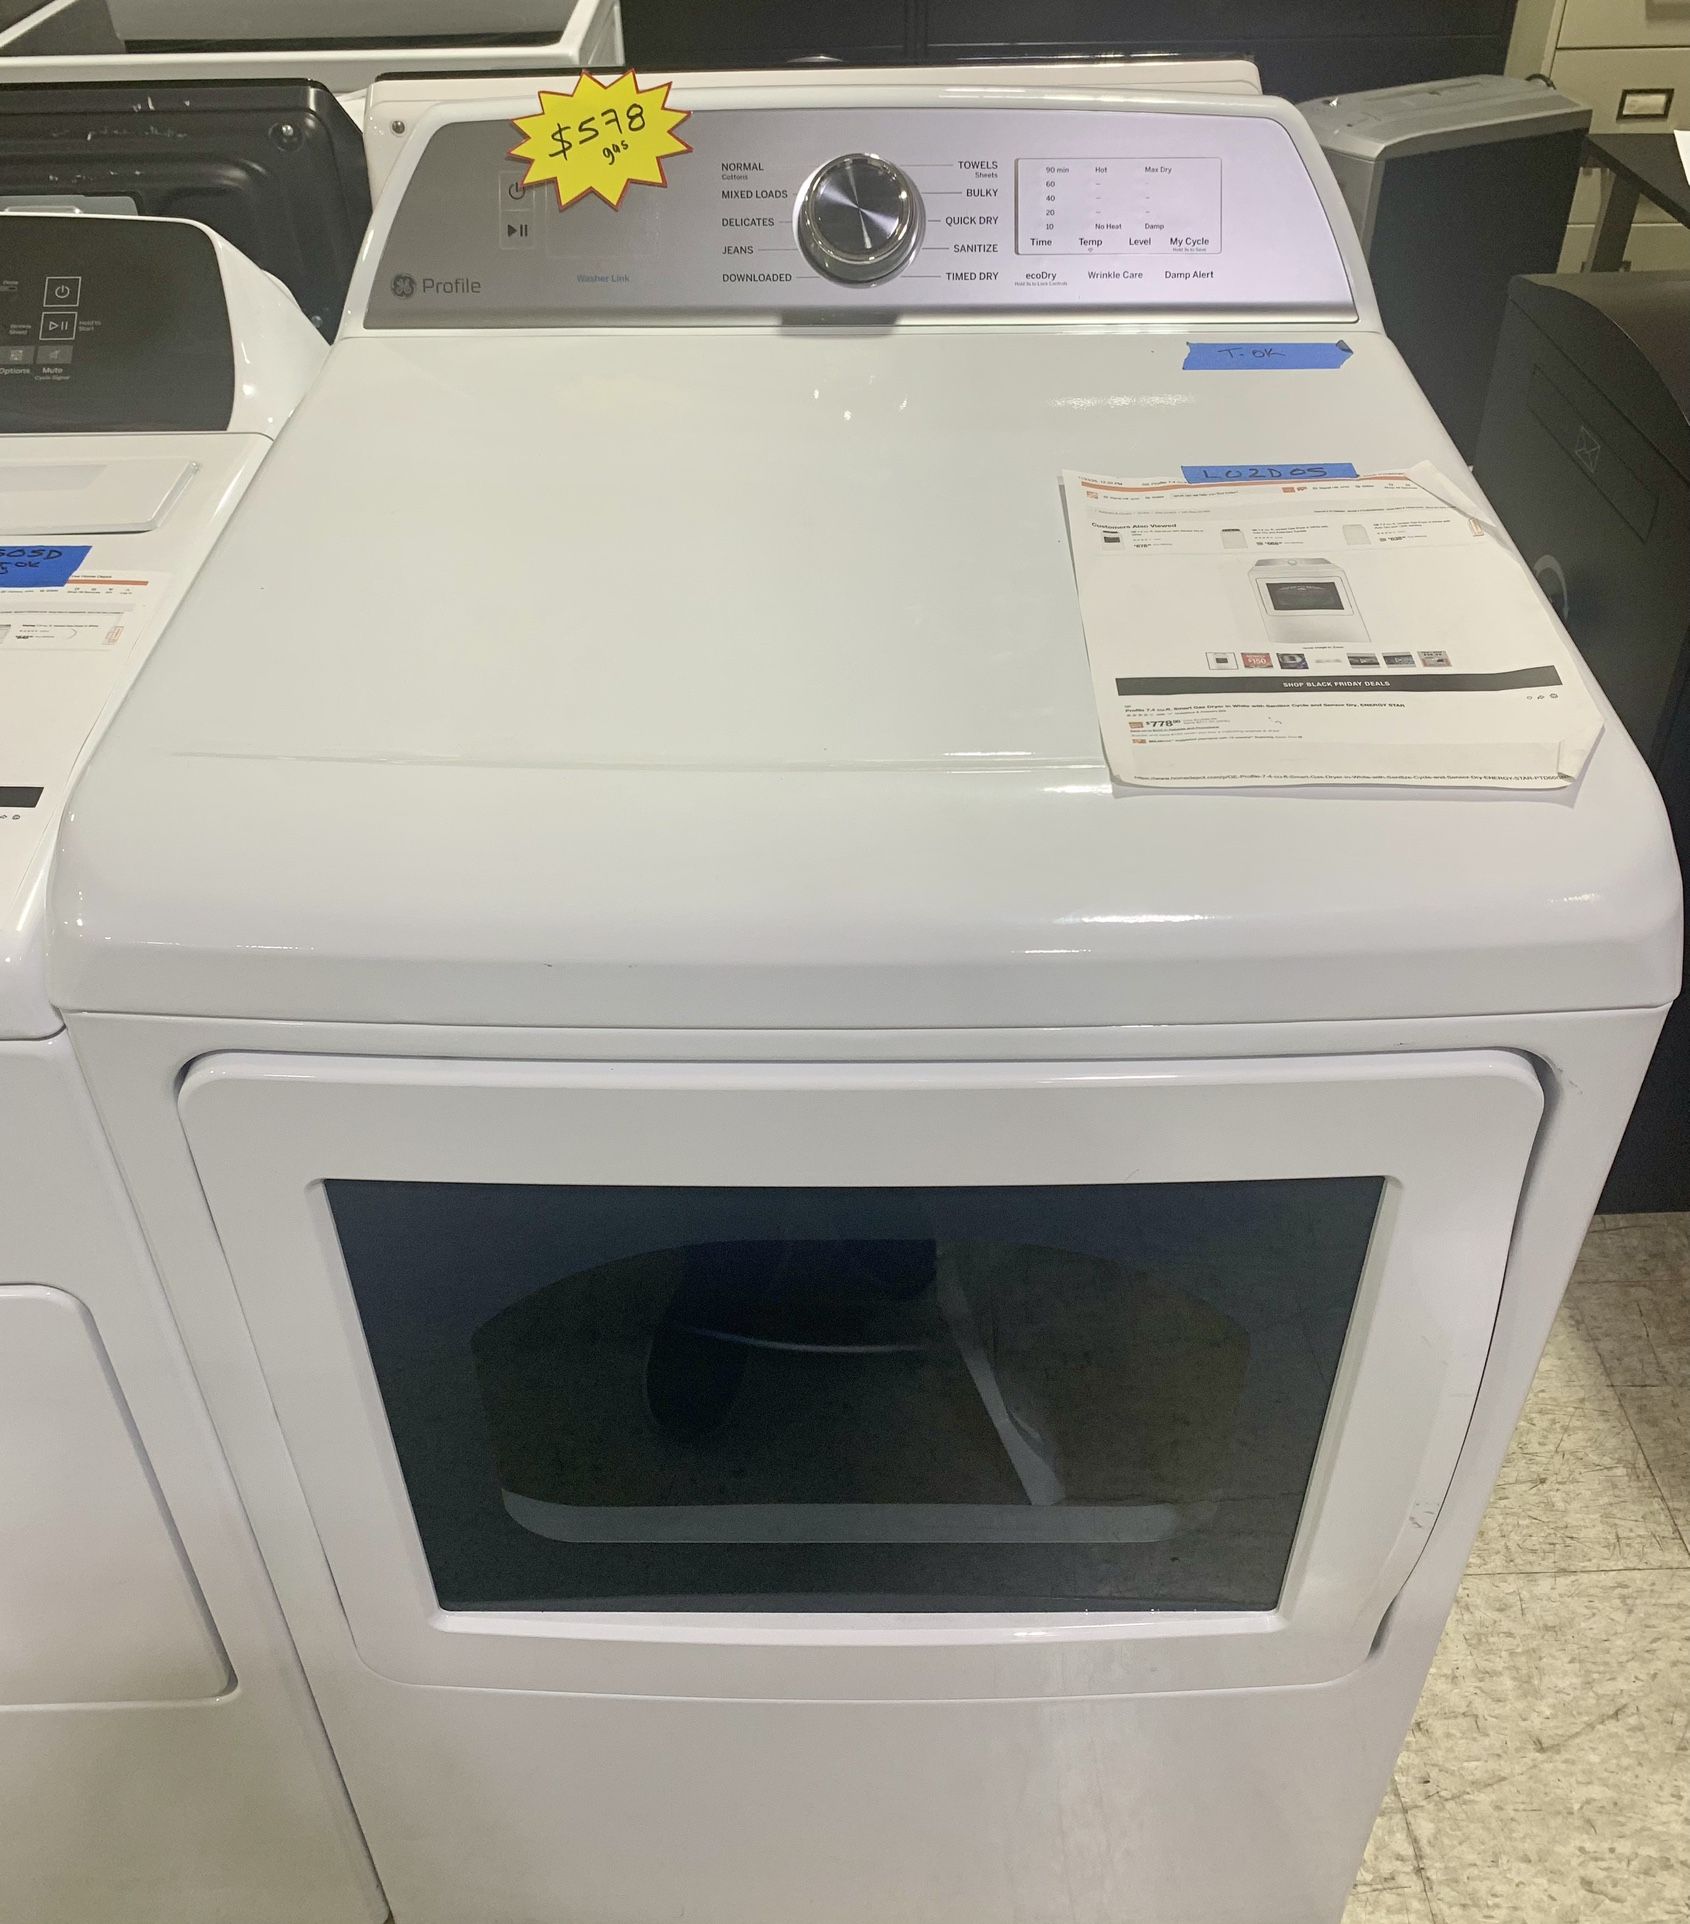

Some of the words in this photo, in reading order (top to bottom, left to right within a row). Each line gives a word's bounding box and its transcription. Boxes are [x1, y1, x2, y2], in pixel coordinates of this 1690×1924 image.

[549, 103, 646, 161] $578
[602, 140, 629, 165] gas
[721, 162, 764, 172] NORMAL
[958, 161, 998, 170] TOWELS
[1045, 166, 1056, 174] 90
[1057, 166, 1070, 174] min
[1095, 166, 1108, 174] Hot
[1144, 166, 1159, 174] Max
[1160, 166, 1173, 175] Dry
[1045, 180, 1056, 188] 60
[721, 190, 753, 199] MIXED
[755, 190, 788, 199] LOADS
[966, 188, 999, 198] BULKY
[1045, 194, 1056, 202] 40
[721, 218, 775, 227] DELICATES
[945, 216, 977, 227] QUICK
[979, 216, 999, 225] DRY
[1144, 223, 1165, 231] Damp
[1030, 237, 1053, 247] Time
[1078, 237, 1103, 248] Temp
[1128, 237, 1152, 246] Level
[1169, 237, 1184, 247] My
[1185, 237, 1210, 247] Cycle
[722, 245, 754, 255] JEANS
[953, 244, 999, 253] SANITIZE
[577, 273, 609, 283] Washer
[611, 273, 630, 283] Link
[722, 273, 792, 282] DOWNLOADED
[945, 272, 977, 281] TIMED
[979, 272, 999, 281] DRY
[1025, 271, 1057, 281] ecoDry
[1087, 270, 1120, 280] Wrinkle
[1122, 270, 1144, 280] Care
[1164, 270, 1191, 281] Damp
[1192, 270, 1214, 280] Alert
[423, 277, 482, 294] Profile
[0, 367, 30, 376] Options
[1091, 522, 1131, 531] Customers
